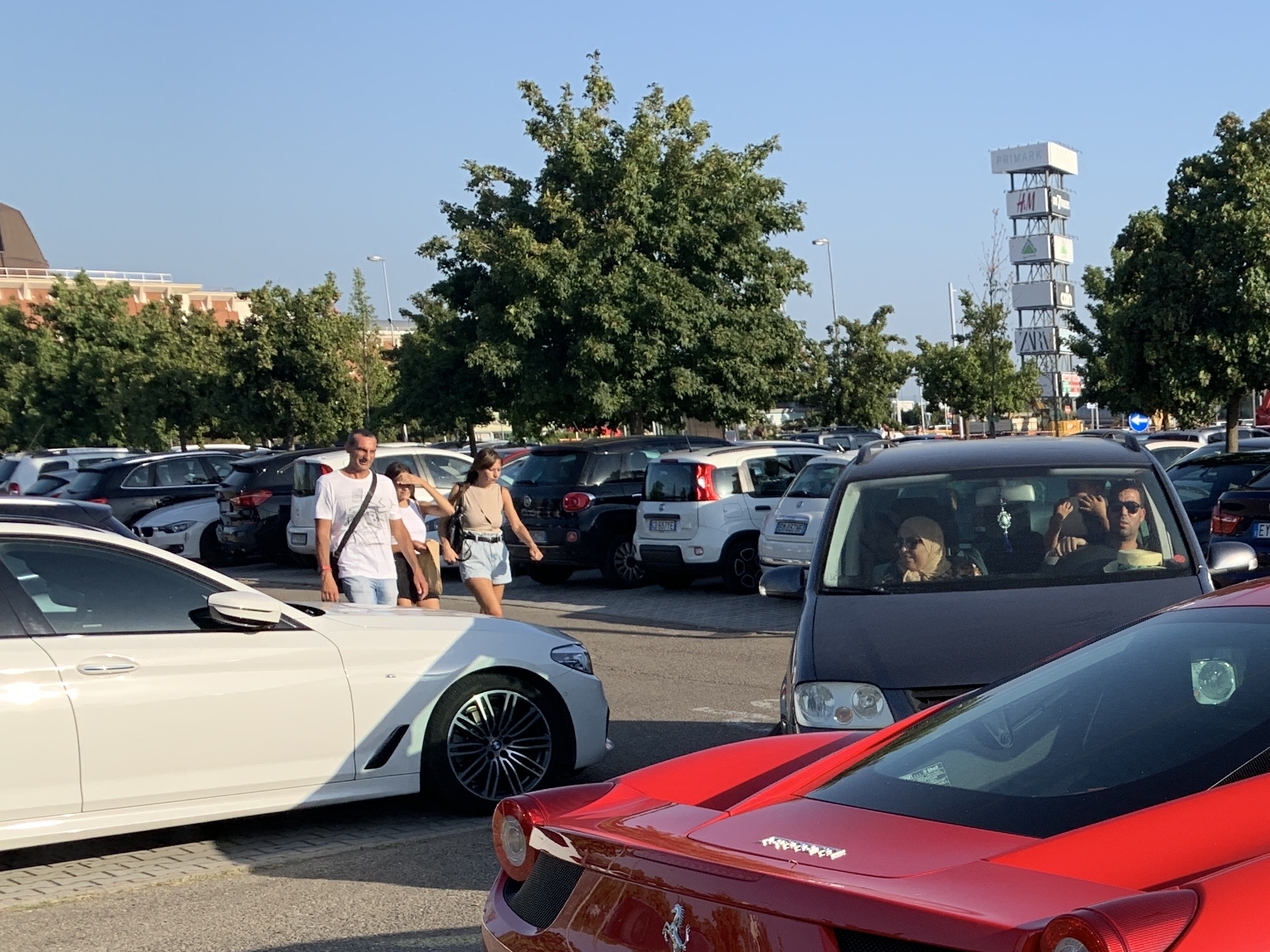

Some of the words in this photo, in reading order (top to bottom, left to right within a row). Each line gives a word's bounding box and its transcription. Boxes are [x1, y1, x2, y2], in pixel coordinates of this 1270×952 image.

[996, 149, 1042, 165] PRIMARK
[1019, 330, 1050, 352] ZARA
[1258, 524, 1270, 537] EY
